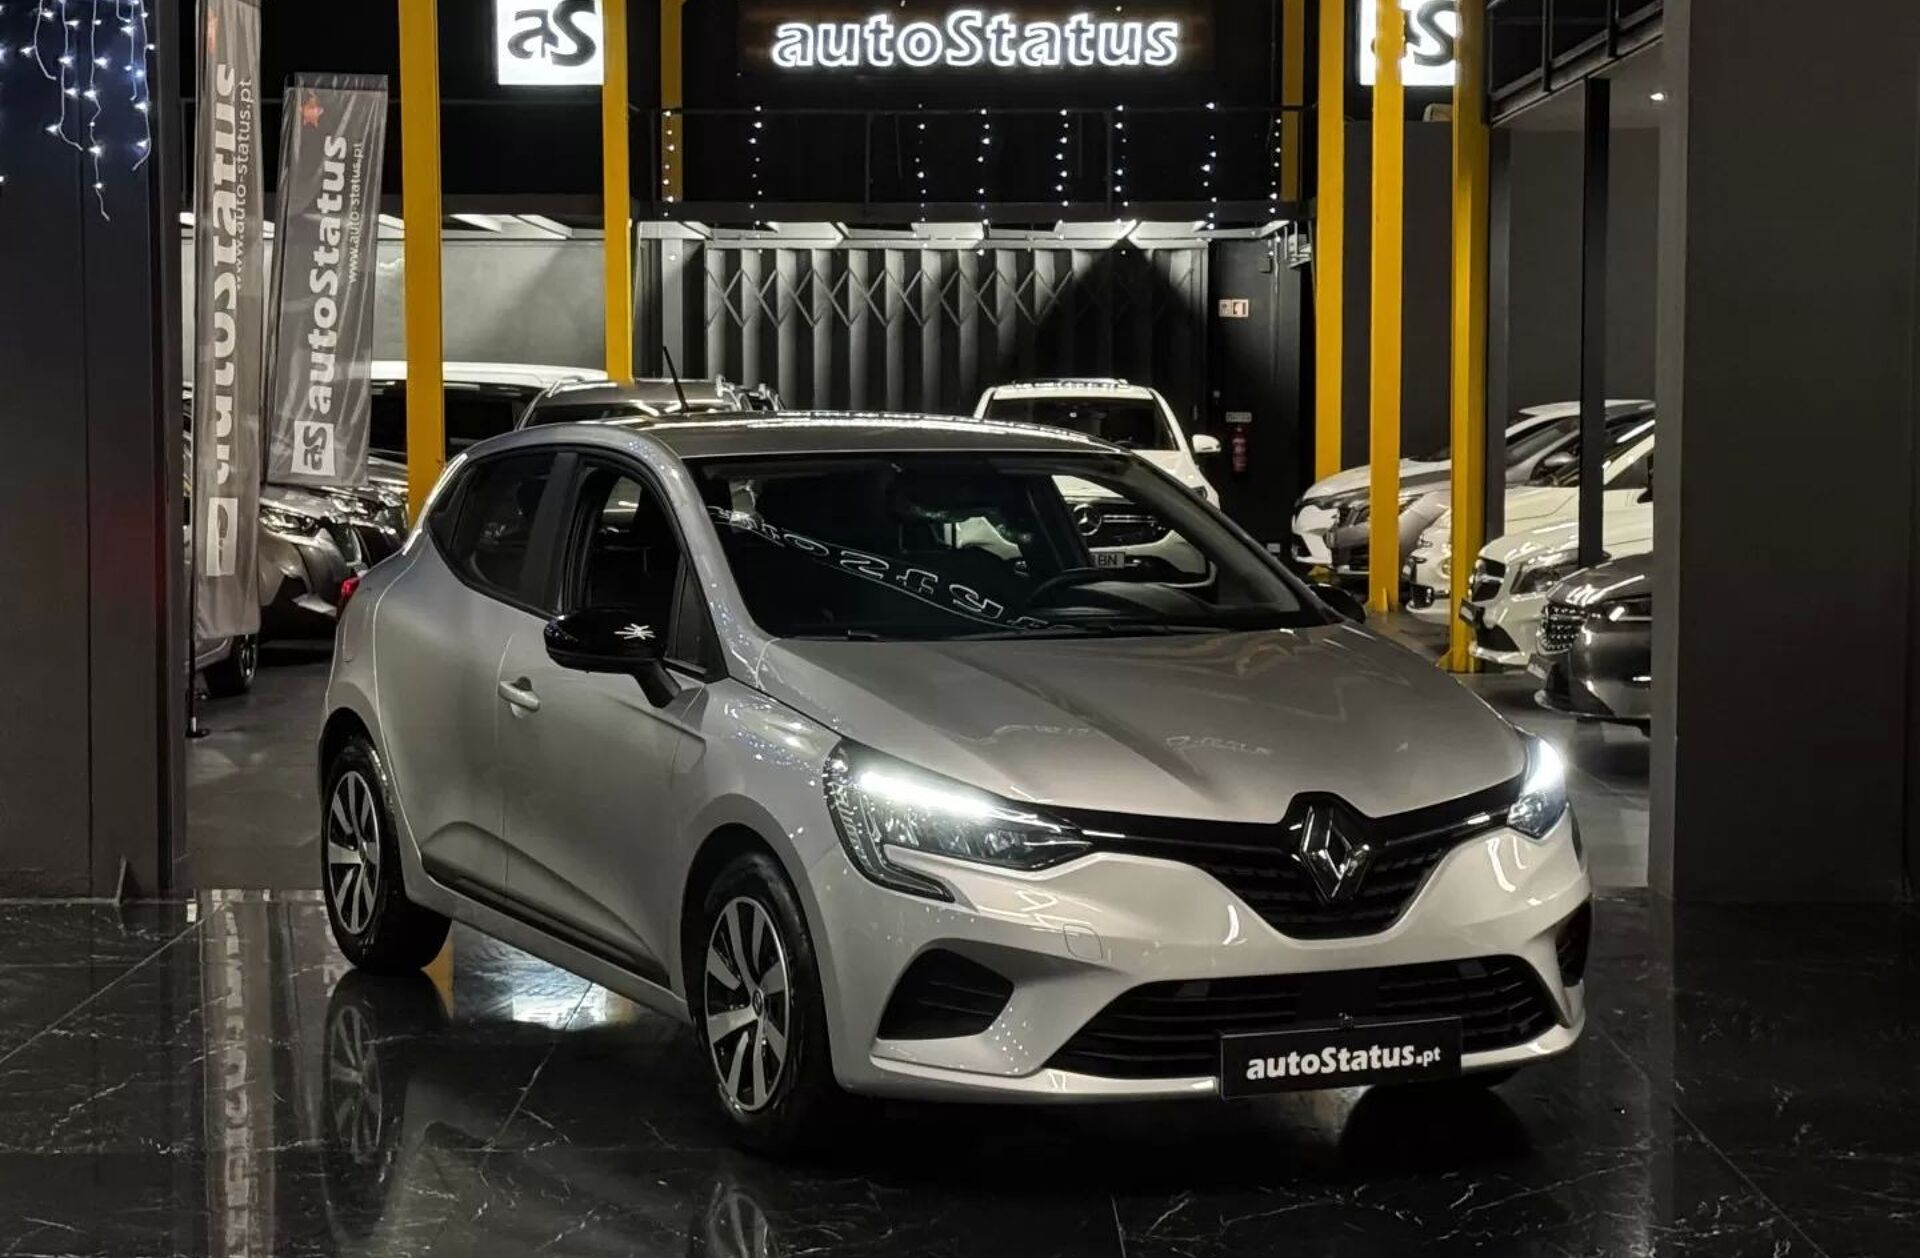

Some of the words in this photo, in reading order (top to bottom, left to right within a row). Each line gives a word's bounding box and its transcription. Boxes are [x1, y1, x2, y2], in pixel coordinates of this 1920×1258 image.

[772, 10, 1179, 67] autoStatus
[306, 135, 347, 415] autoStatus
[1246, 1044, 1441, 1080] autoStatus.pt
